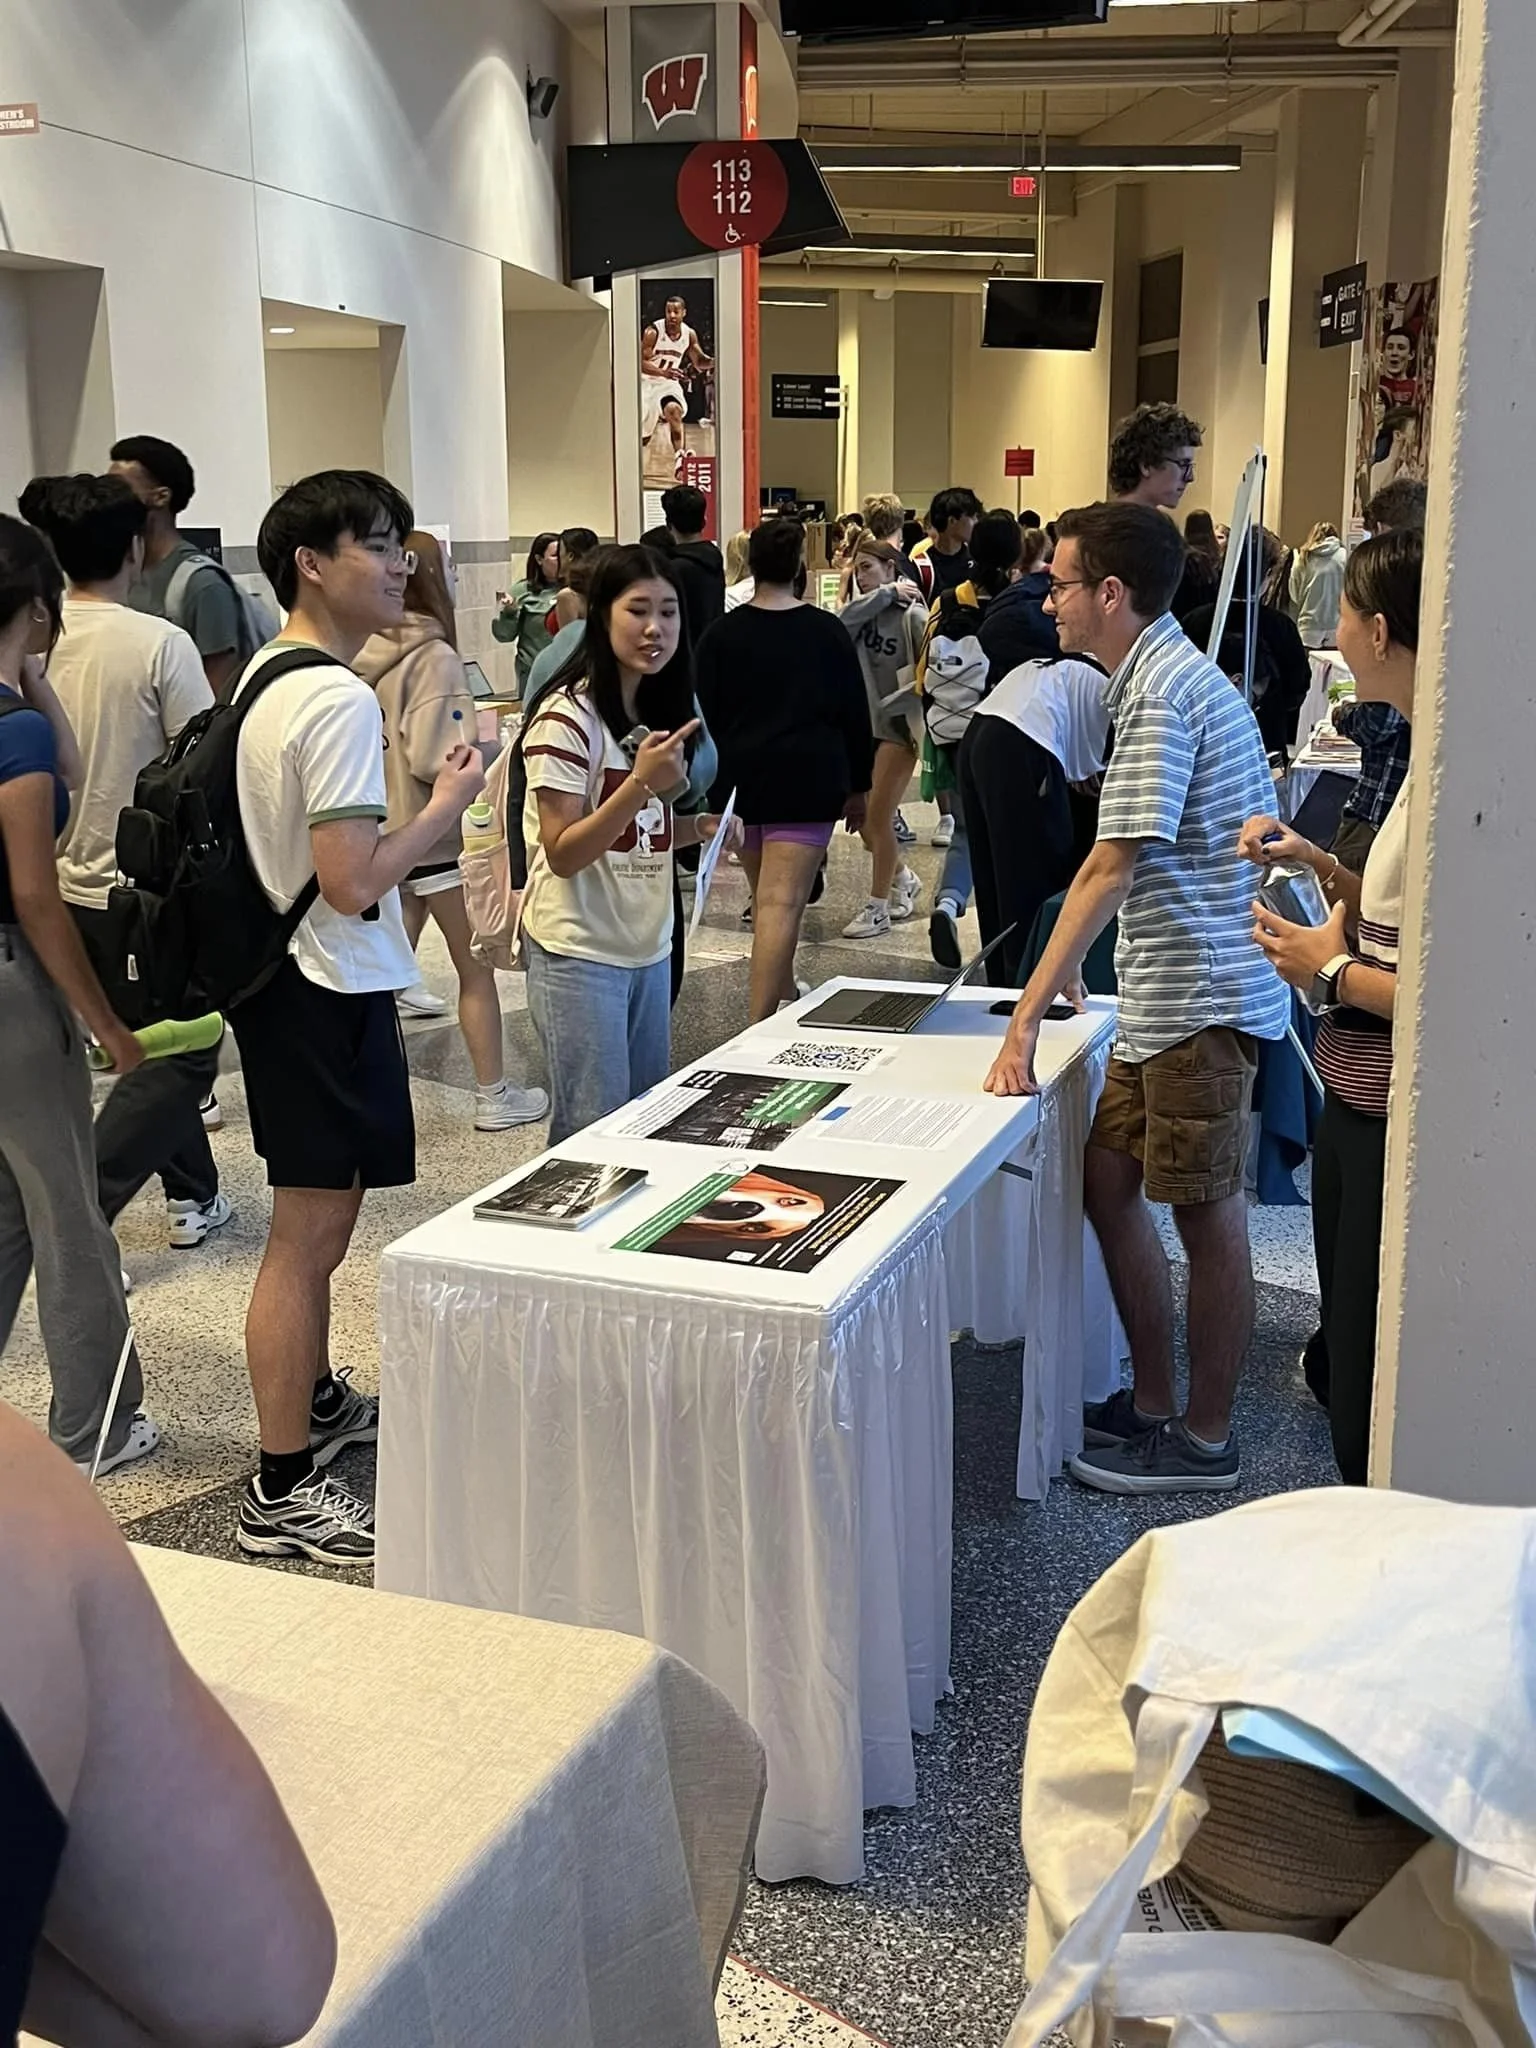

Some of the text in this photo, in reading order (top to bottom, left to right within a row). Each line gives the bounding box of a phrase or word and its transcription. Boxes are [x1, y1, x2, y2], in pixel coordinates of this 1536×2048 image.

[712, 159, 752, 182] 113
[1013, 177, 1033, 195] EXIT
[712, 191, 752, 214] 112
[1338, 283, 1356, 302] GATE
[1341, 310, 1356, 328] EXIT
[698, 463, 712, 493] 2011
